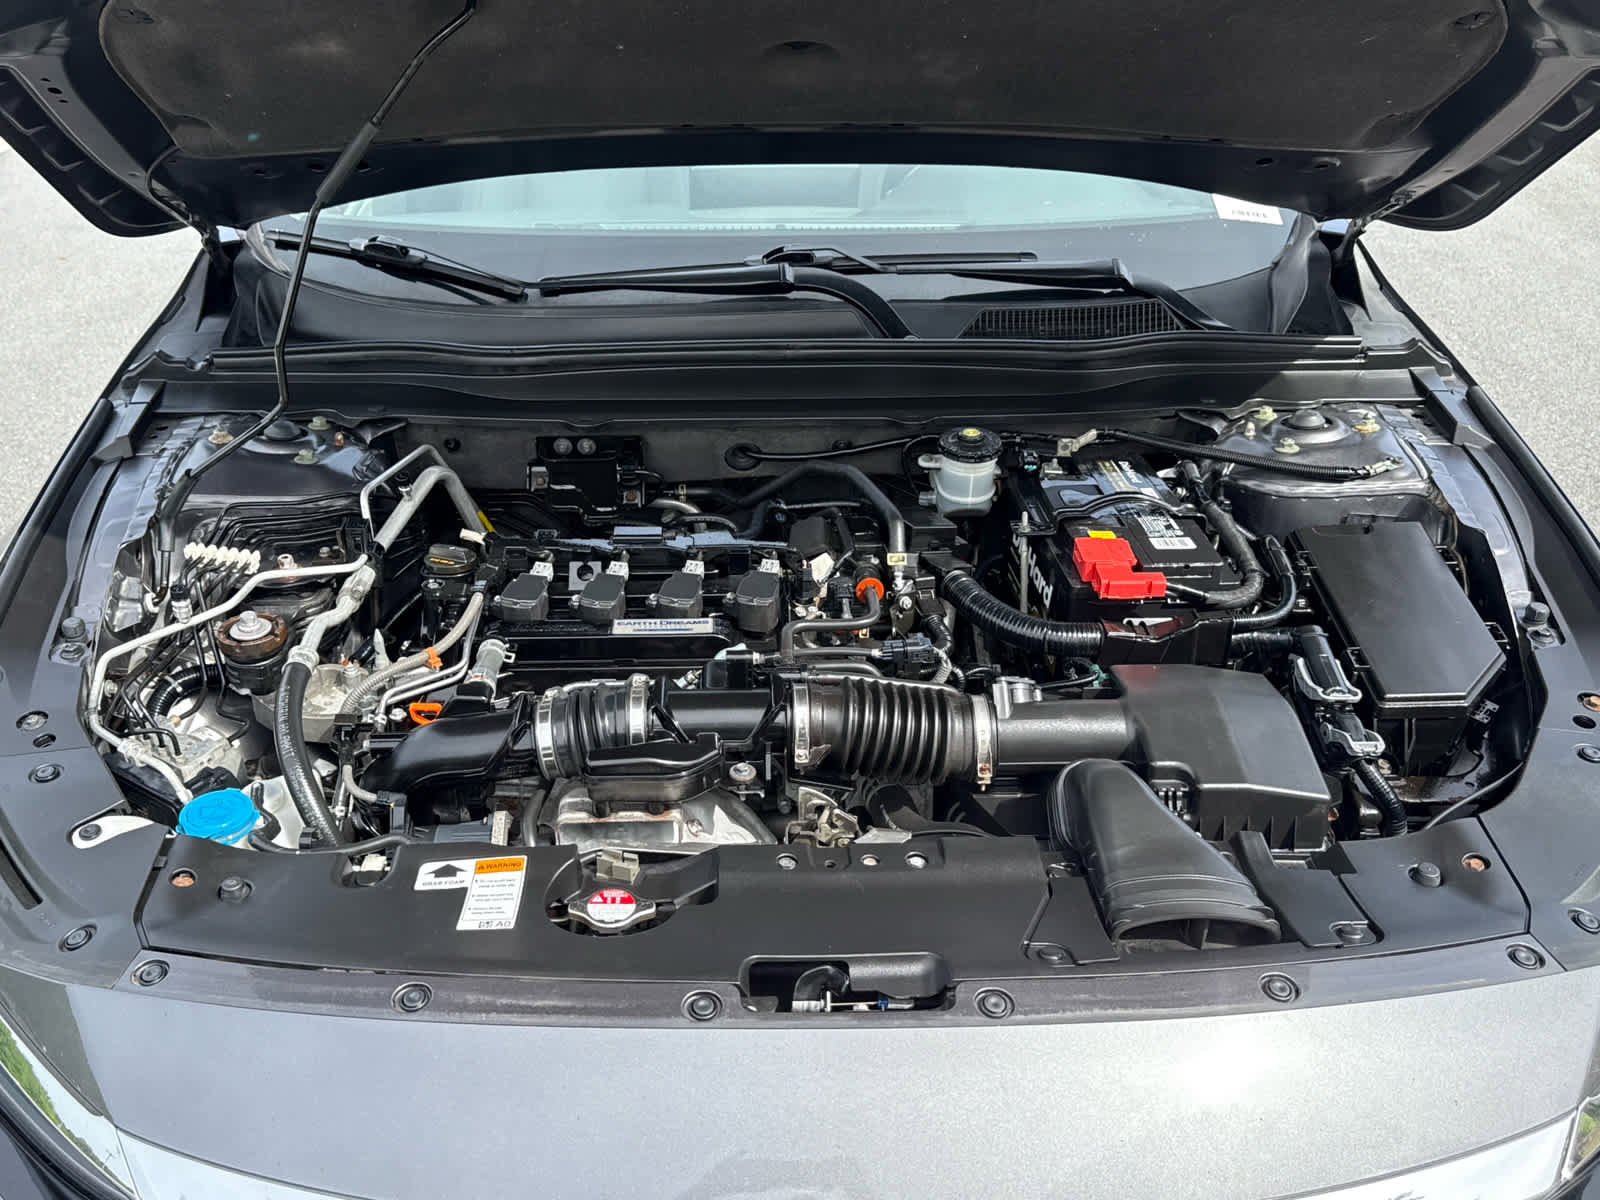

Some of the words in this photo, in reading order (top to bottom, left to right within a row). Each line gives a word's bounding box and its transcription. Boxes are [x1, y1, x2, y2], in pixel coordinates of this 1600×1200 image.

[1011, 532, 1054, 609] Hard
[659, 619, 710, 627] DREAMS
[486, 861, 522, 870] WARNING
